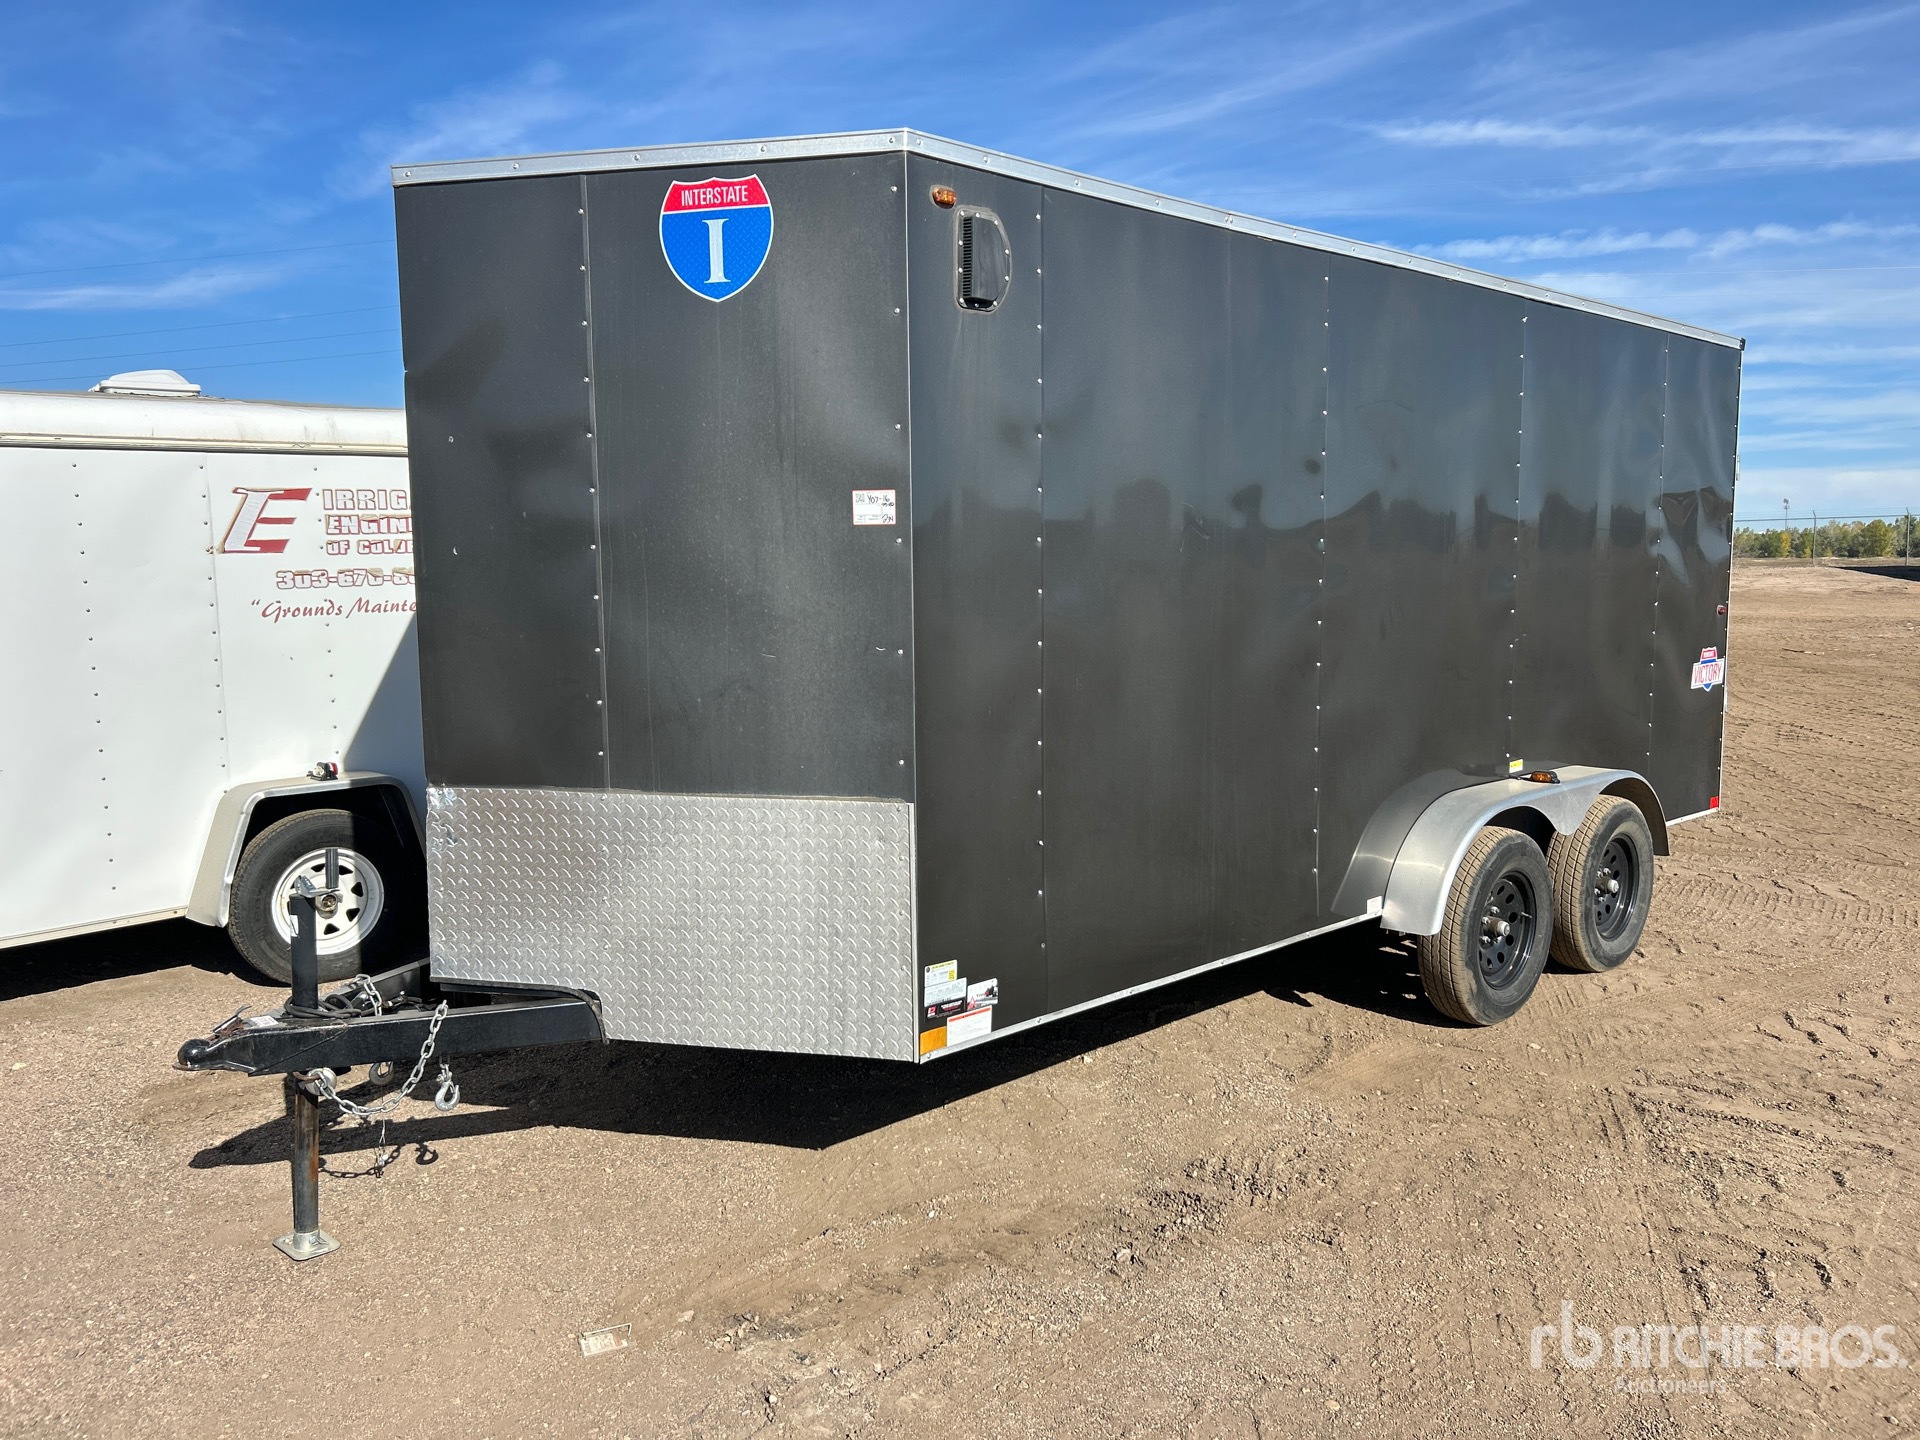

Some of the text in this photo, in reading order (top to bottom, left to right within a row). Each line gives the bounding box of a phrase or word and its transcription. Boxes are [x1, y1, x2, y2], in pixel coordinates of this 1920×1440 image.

[681, 185, 748, 206] INTERSTATE
[702, 218, 731, 284] I
[322, 489, 411, 511] IRRIG
[1694, 663, 1722, 684] VICTORY
